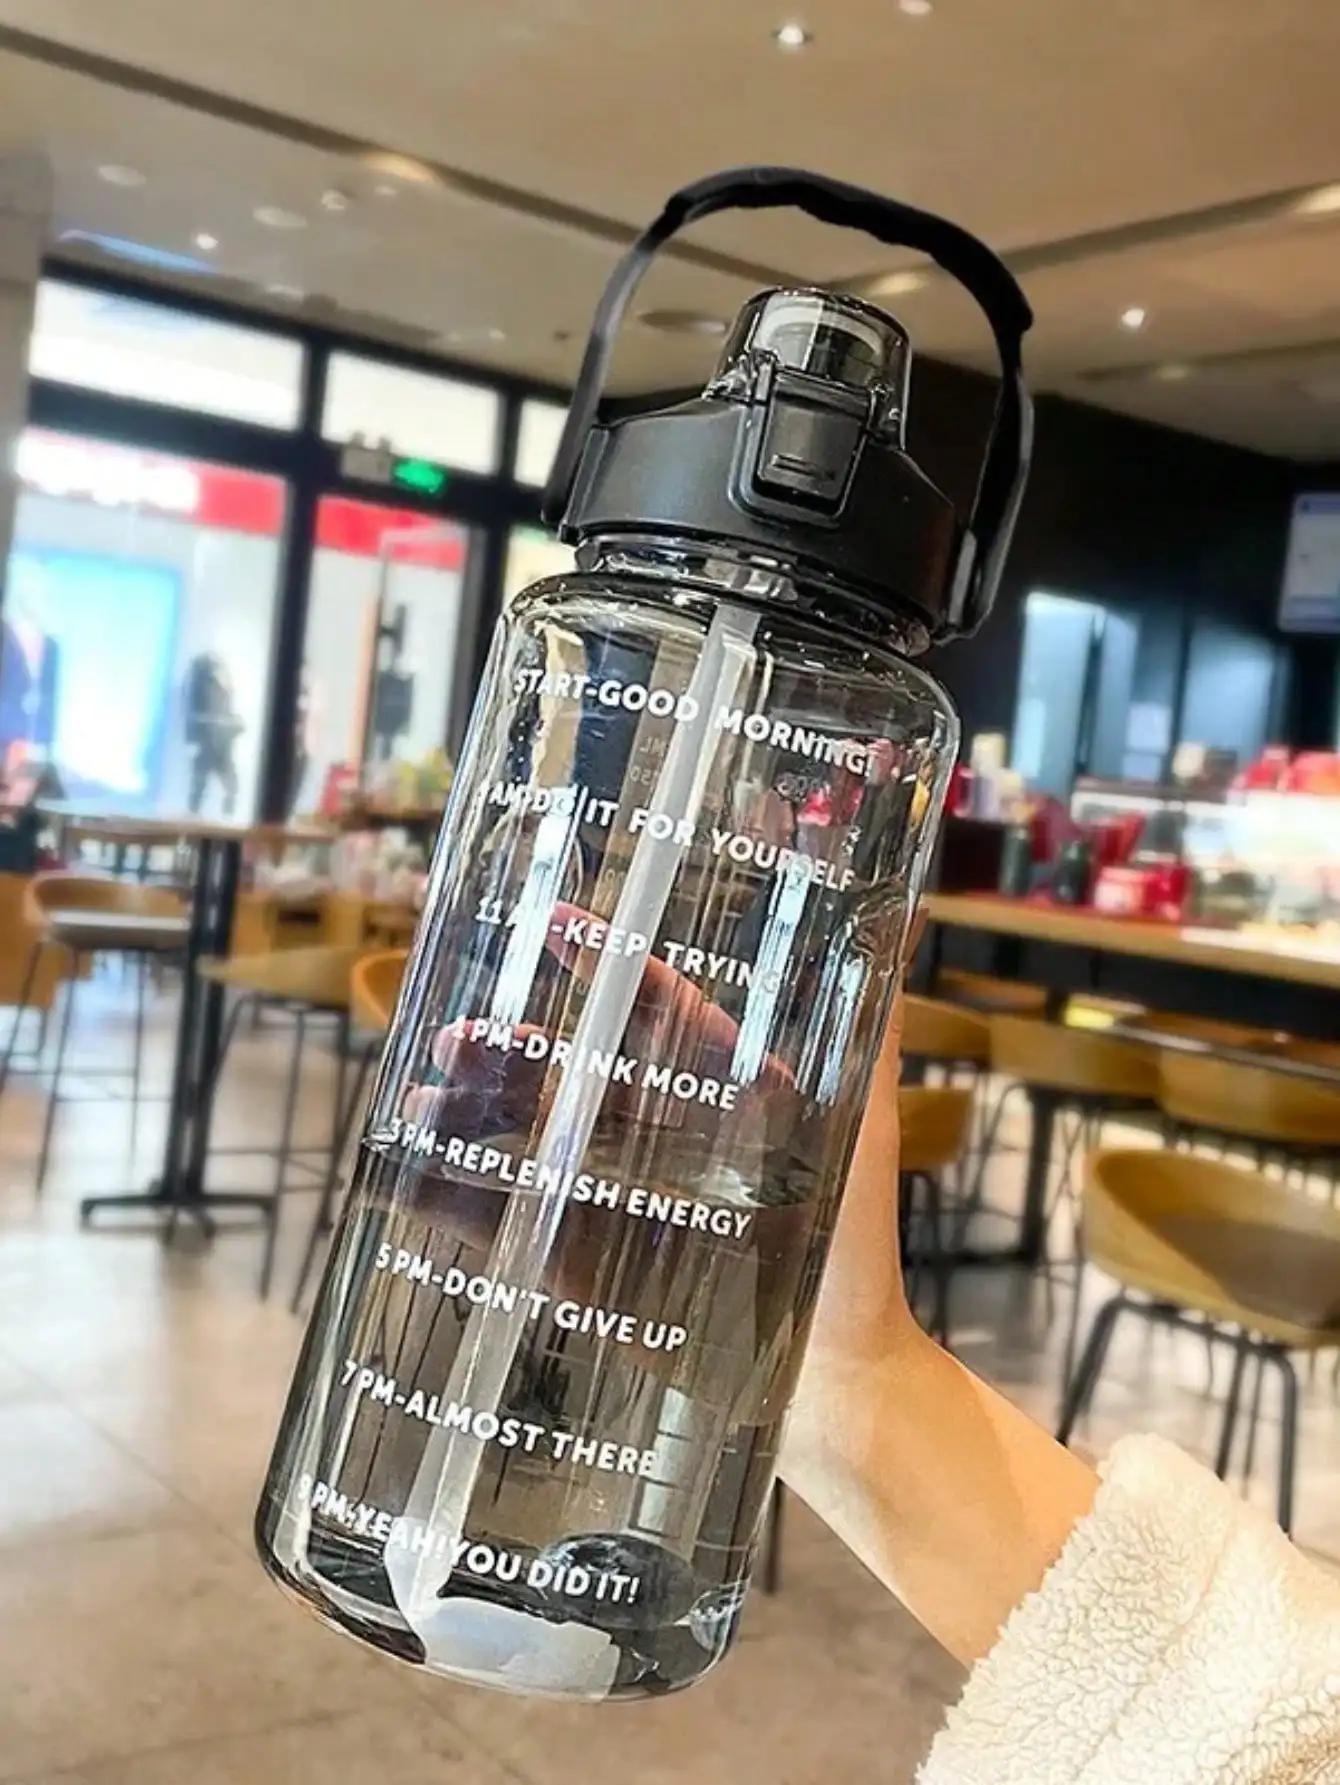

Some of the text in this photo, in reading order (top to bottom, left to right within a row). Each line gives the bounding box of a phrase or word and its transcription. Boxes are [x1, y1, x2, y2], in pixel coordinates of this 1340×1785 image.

[513, 668, 875, 779] START-GOOD MORNING!
[584, 797, 620, 827] IT
[628, 807, 697, 847] FOR
[711, 828, 855, 893] YOURSELF
[641, 1063, 741, 1111] MORE
[626, 1188, 752, 1240] ENERGY
[553, 1301, 638, 1344] GIVE
[643, 1322, 688, 1353] UP
[551, 1430, 658, 1477] THERE
[527, 1558, 592, 1599] DID
[596, 1572, 641, 1604] IT!
